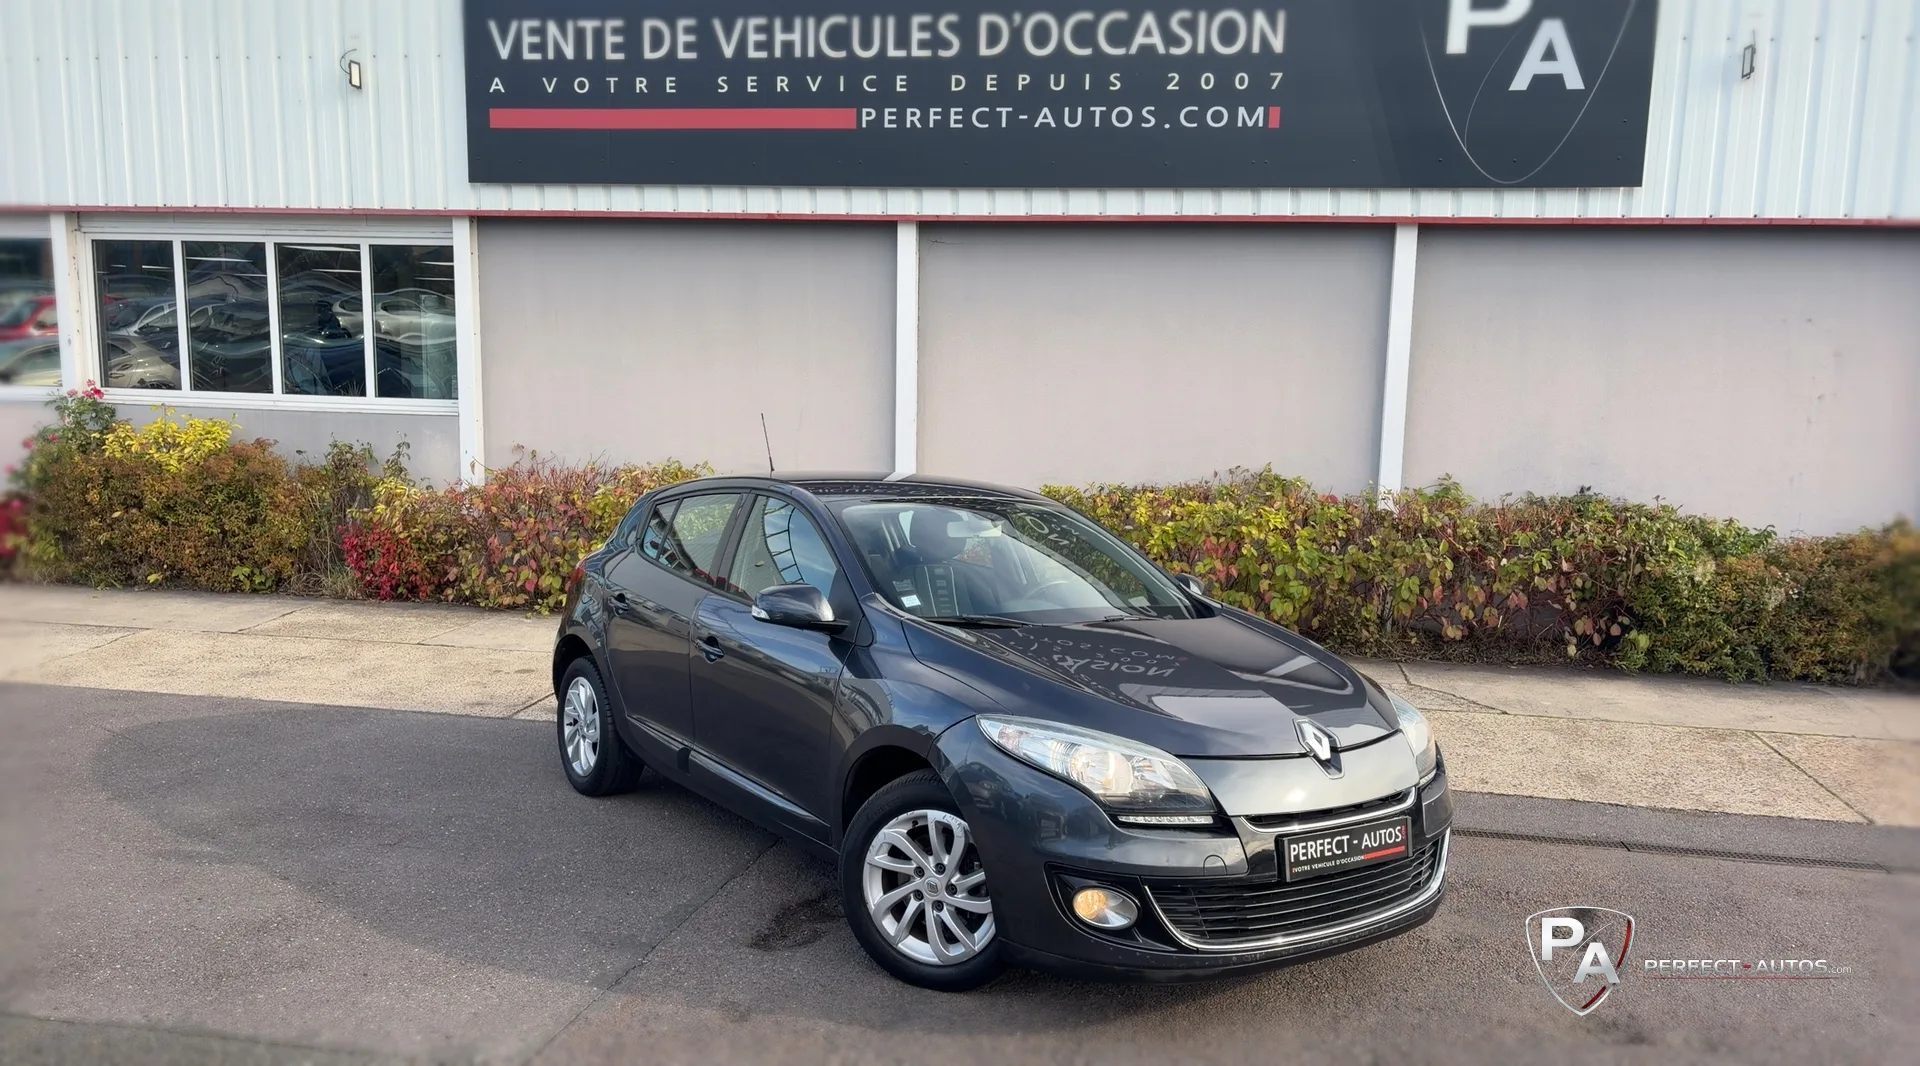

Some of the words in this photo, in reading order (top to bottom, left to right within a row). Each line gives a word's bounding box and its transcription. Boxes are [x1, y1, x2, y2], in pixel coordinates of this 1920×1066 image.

[488, 19, 625, 60] VENTE
[642, 18, 697, 60] DE
[712, 13, 961, 59] VEHICULES
[978, 9, 1286, 57] D'OCCASION
[489, 77, 505, 93] A
[542, 77, 677, 93] VOTRE
[717, 74, 907, 93] SERVICE
[951, 73, 1122, 92] DEPUIS
[1166, 72, 1283, 91] 2007
[861, 106, 1264, 129] PERFECT-AUTOS.COM
[1290, 835, 1350, 862] PERFECT
[1361, 826, 1401, 849] AUTOS
[1311, 860, 1335, 870] VEHICULE
